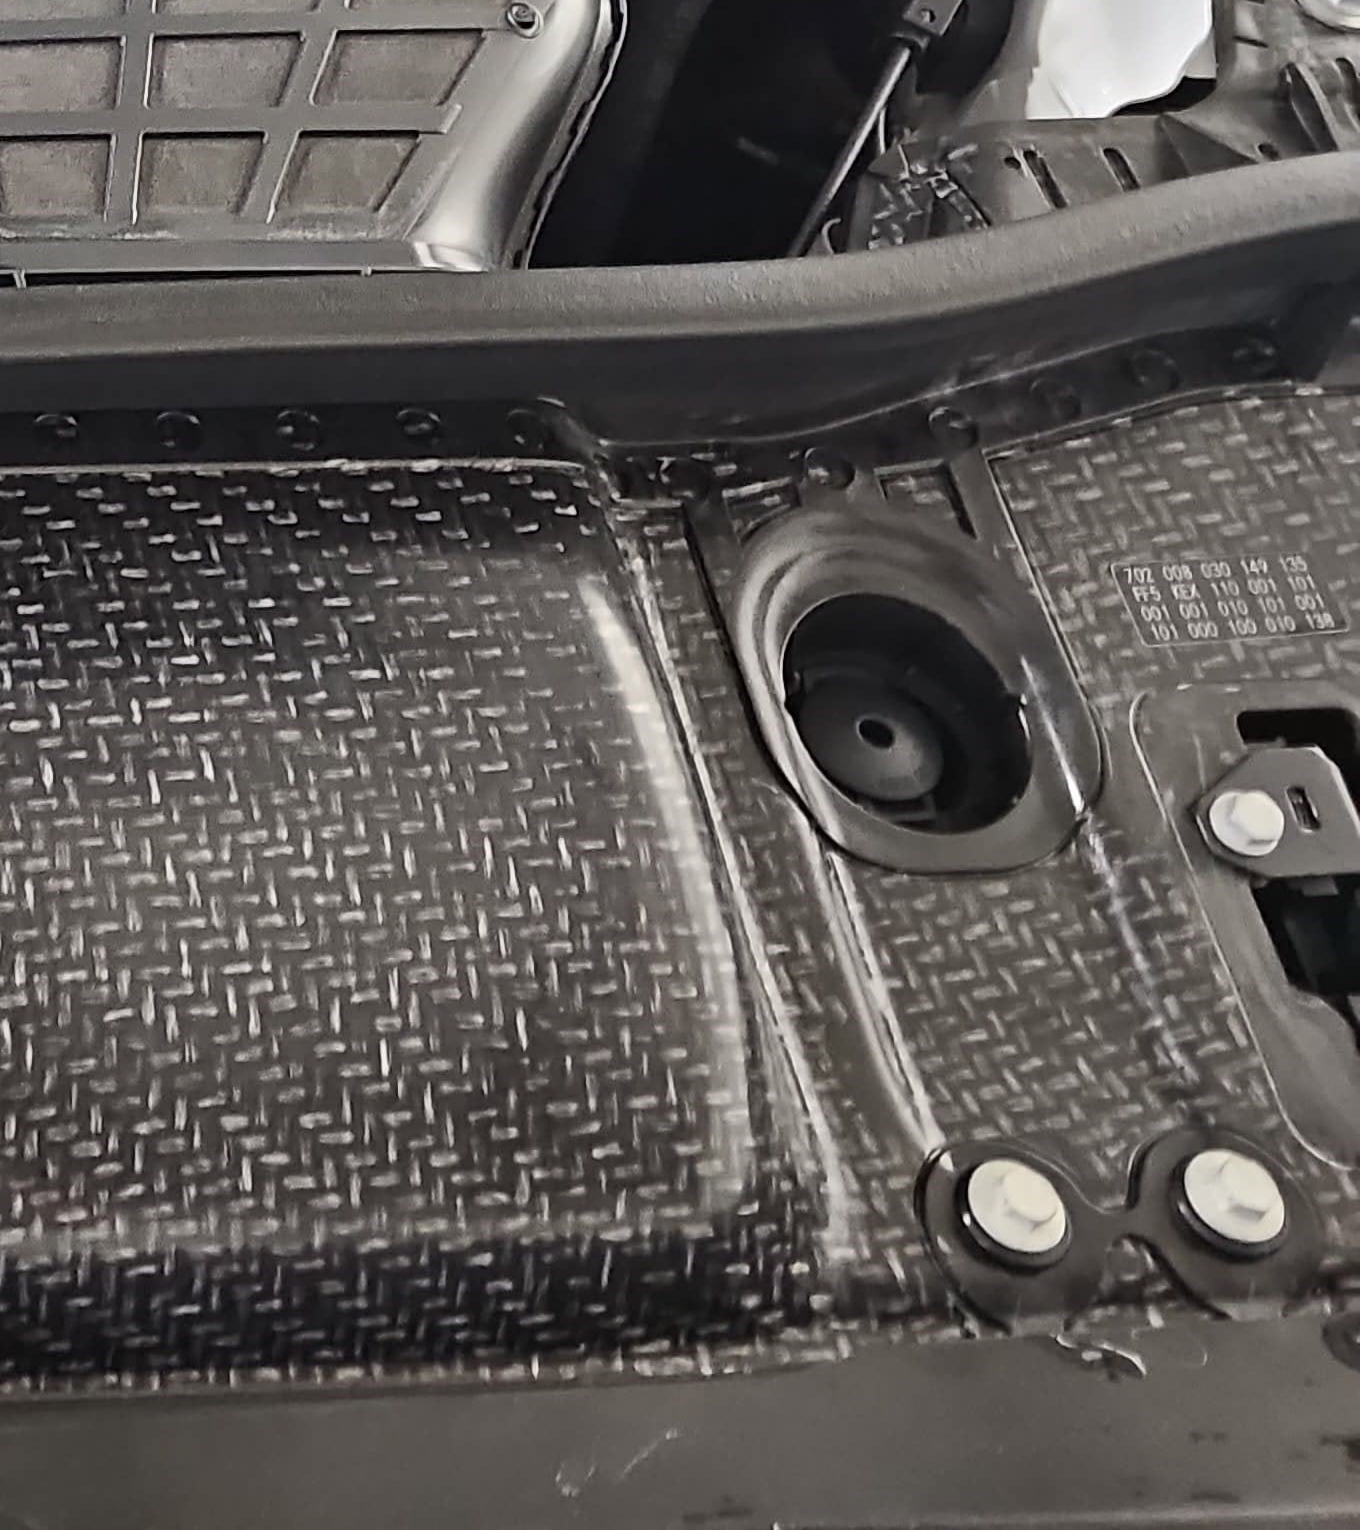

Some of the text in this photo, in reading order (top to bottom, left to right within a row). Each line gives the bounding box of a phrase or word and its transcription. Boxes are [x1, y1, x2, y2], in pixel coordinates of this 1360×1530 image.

[1124, 567, 1154, 584] 702
[1163, 564, 1193, 582] 008
[1200, 561, 1231, 579] 030
[1280, 556, 1307, 573] 135
[1131, 585, 1161, 603] FF5
[1211, 580, 1240, 597] 110
[1247, 578, 1277, 595] 001
[1287, 574, 1316, 591] 101
[1140, 594, 1325, 622] 001 001 010 101 001
[1150, 624, 1178, 641] 101
[1187, 621, 1218, 639] 000
[1228, 618, 1257, 635] 100
[1265, 615, 1296, 632] 010
